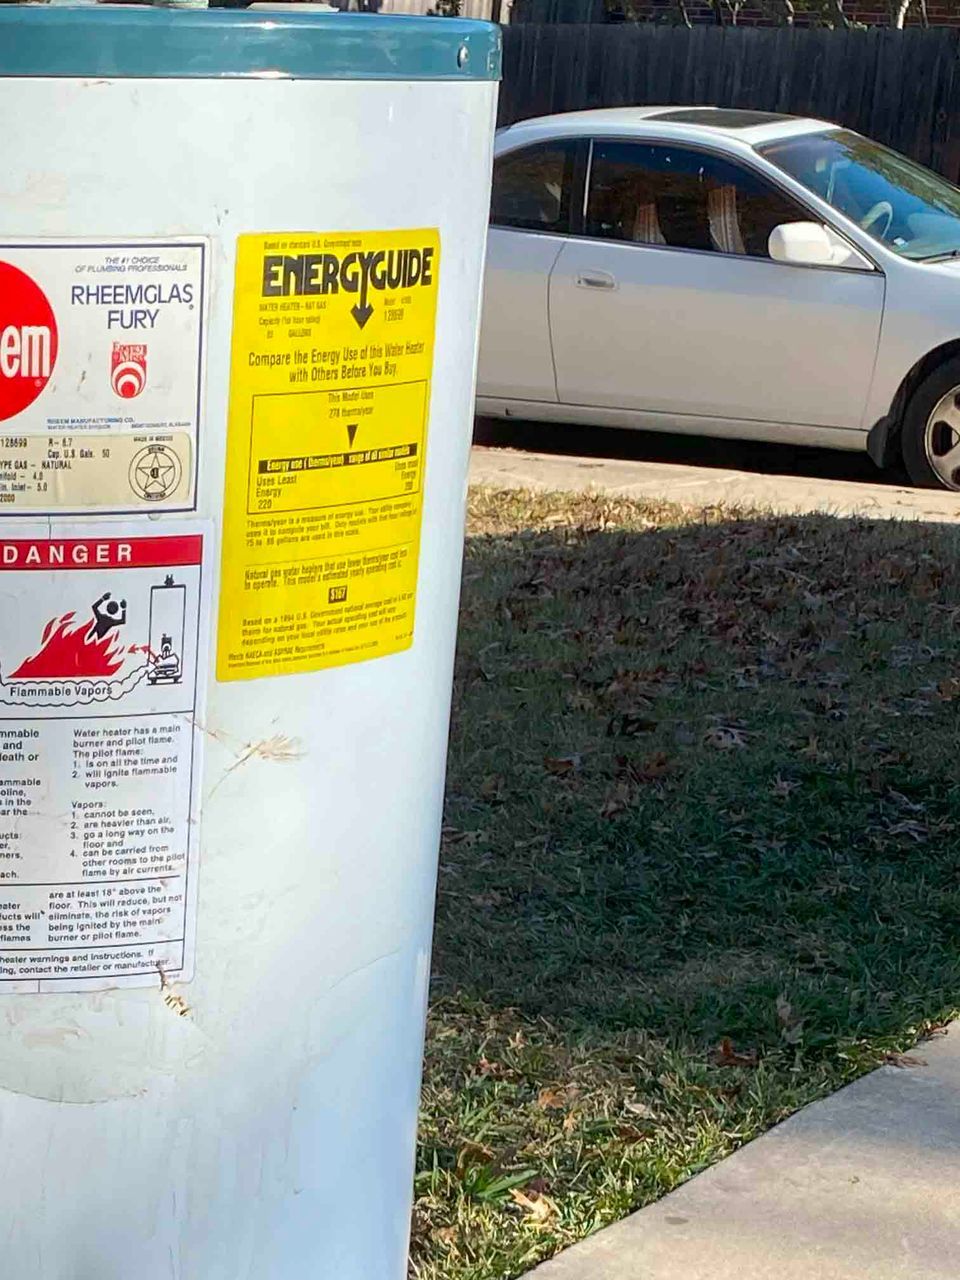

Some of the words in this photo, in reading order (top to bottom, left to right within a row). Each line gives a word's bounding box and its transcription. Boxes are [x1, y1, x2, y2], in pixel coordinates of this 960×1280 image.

[71, 284, 194, 305] RHEEMGLAS
[107, 309, 160, 329] FURY
[249, 352, 290, 368] Compare
[294, 352, 308, 364] the
[311, 350, 340, 366] Energy
[343, 348, 357, 360] Use
[361, 348, 368, 360] of
[370, 346, 382, 358] this
[385, 343, 403, 357] Water
[290, 369, 308, 382] with
[311, 366, 338, 380] Others
[341, 364, 366, 379] Before
[368, 364, 382, 376] You
[102, 449, 109, 458] 50
[15, 461, 27, 469] GAS
[42, 461, 71, 469] NATURAL
[257, 477, 275, 486] Uses
[278, 475, 297, 485] Least
[256, 488, 282, 498] Energy
[258, 500, 272, 510] 220
[3, 544, 132, 563] DANGER
[10, 686, 71, 697] Flammable
[75, 686, 112, 698] Vapors
[74, 729, 99, 737] Water
[103, 728, 131, 736] heater
[134, 727, 149, 736] has
[3, 741, 22, 750] and
[73, 740, 103, 748] burner
[126, 738, 145, 748] pilot
[149, 736, 174, 744] flame.
[93, 750, 113, 760] pilot
[116, 749, 142, 757] flame:
